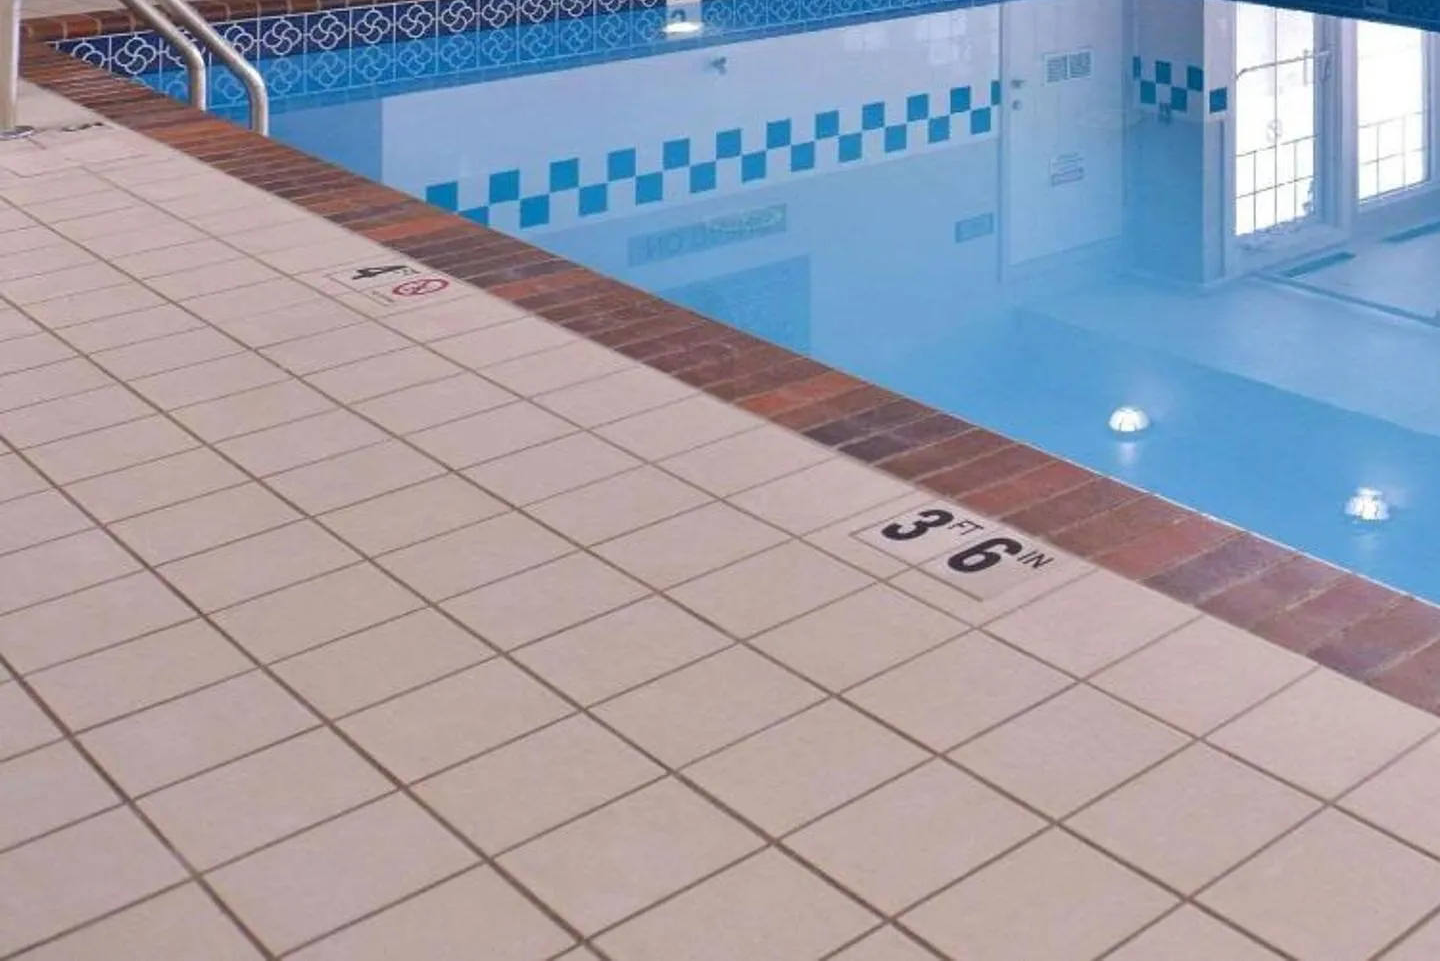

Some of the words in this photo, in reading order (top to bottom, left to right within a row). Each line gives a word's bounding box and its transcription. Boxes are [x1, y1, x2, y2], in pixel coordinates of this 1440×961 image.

[352, 266, 408, 280] 4
[881, 509, 954, 540] 3
[948, 519, 984, 536] FT
[948, 538, 1022, 572] 6
[1017, 549, 1054, 569] IN
